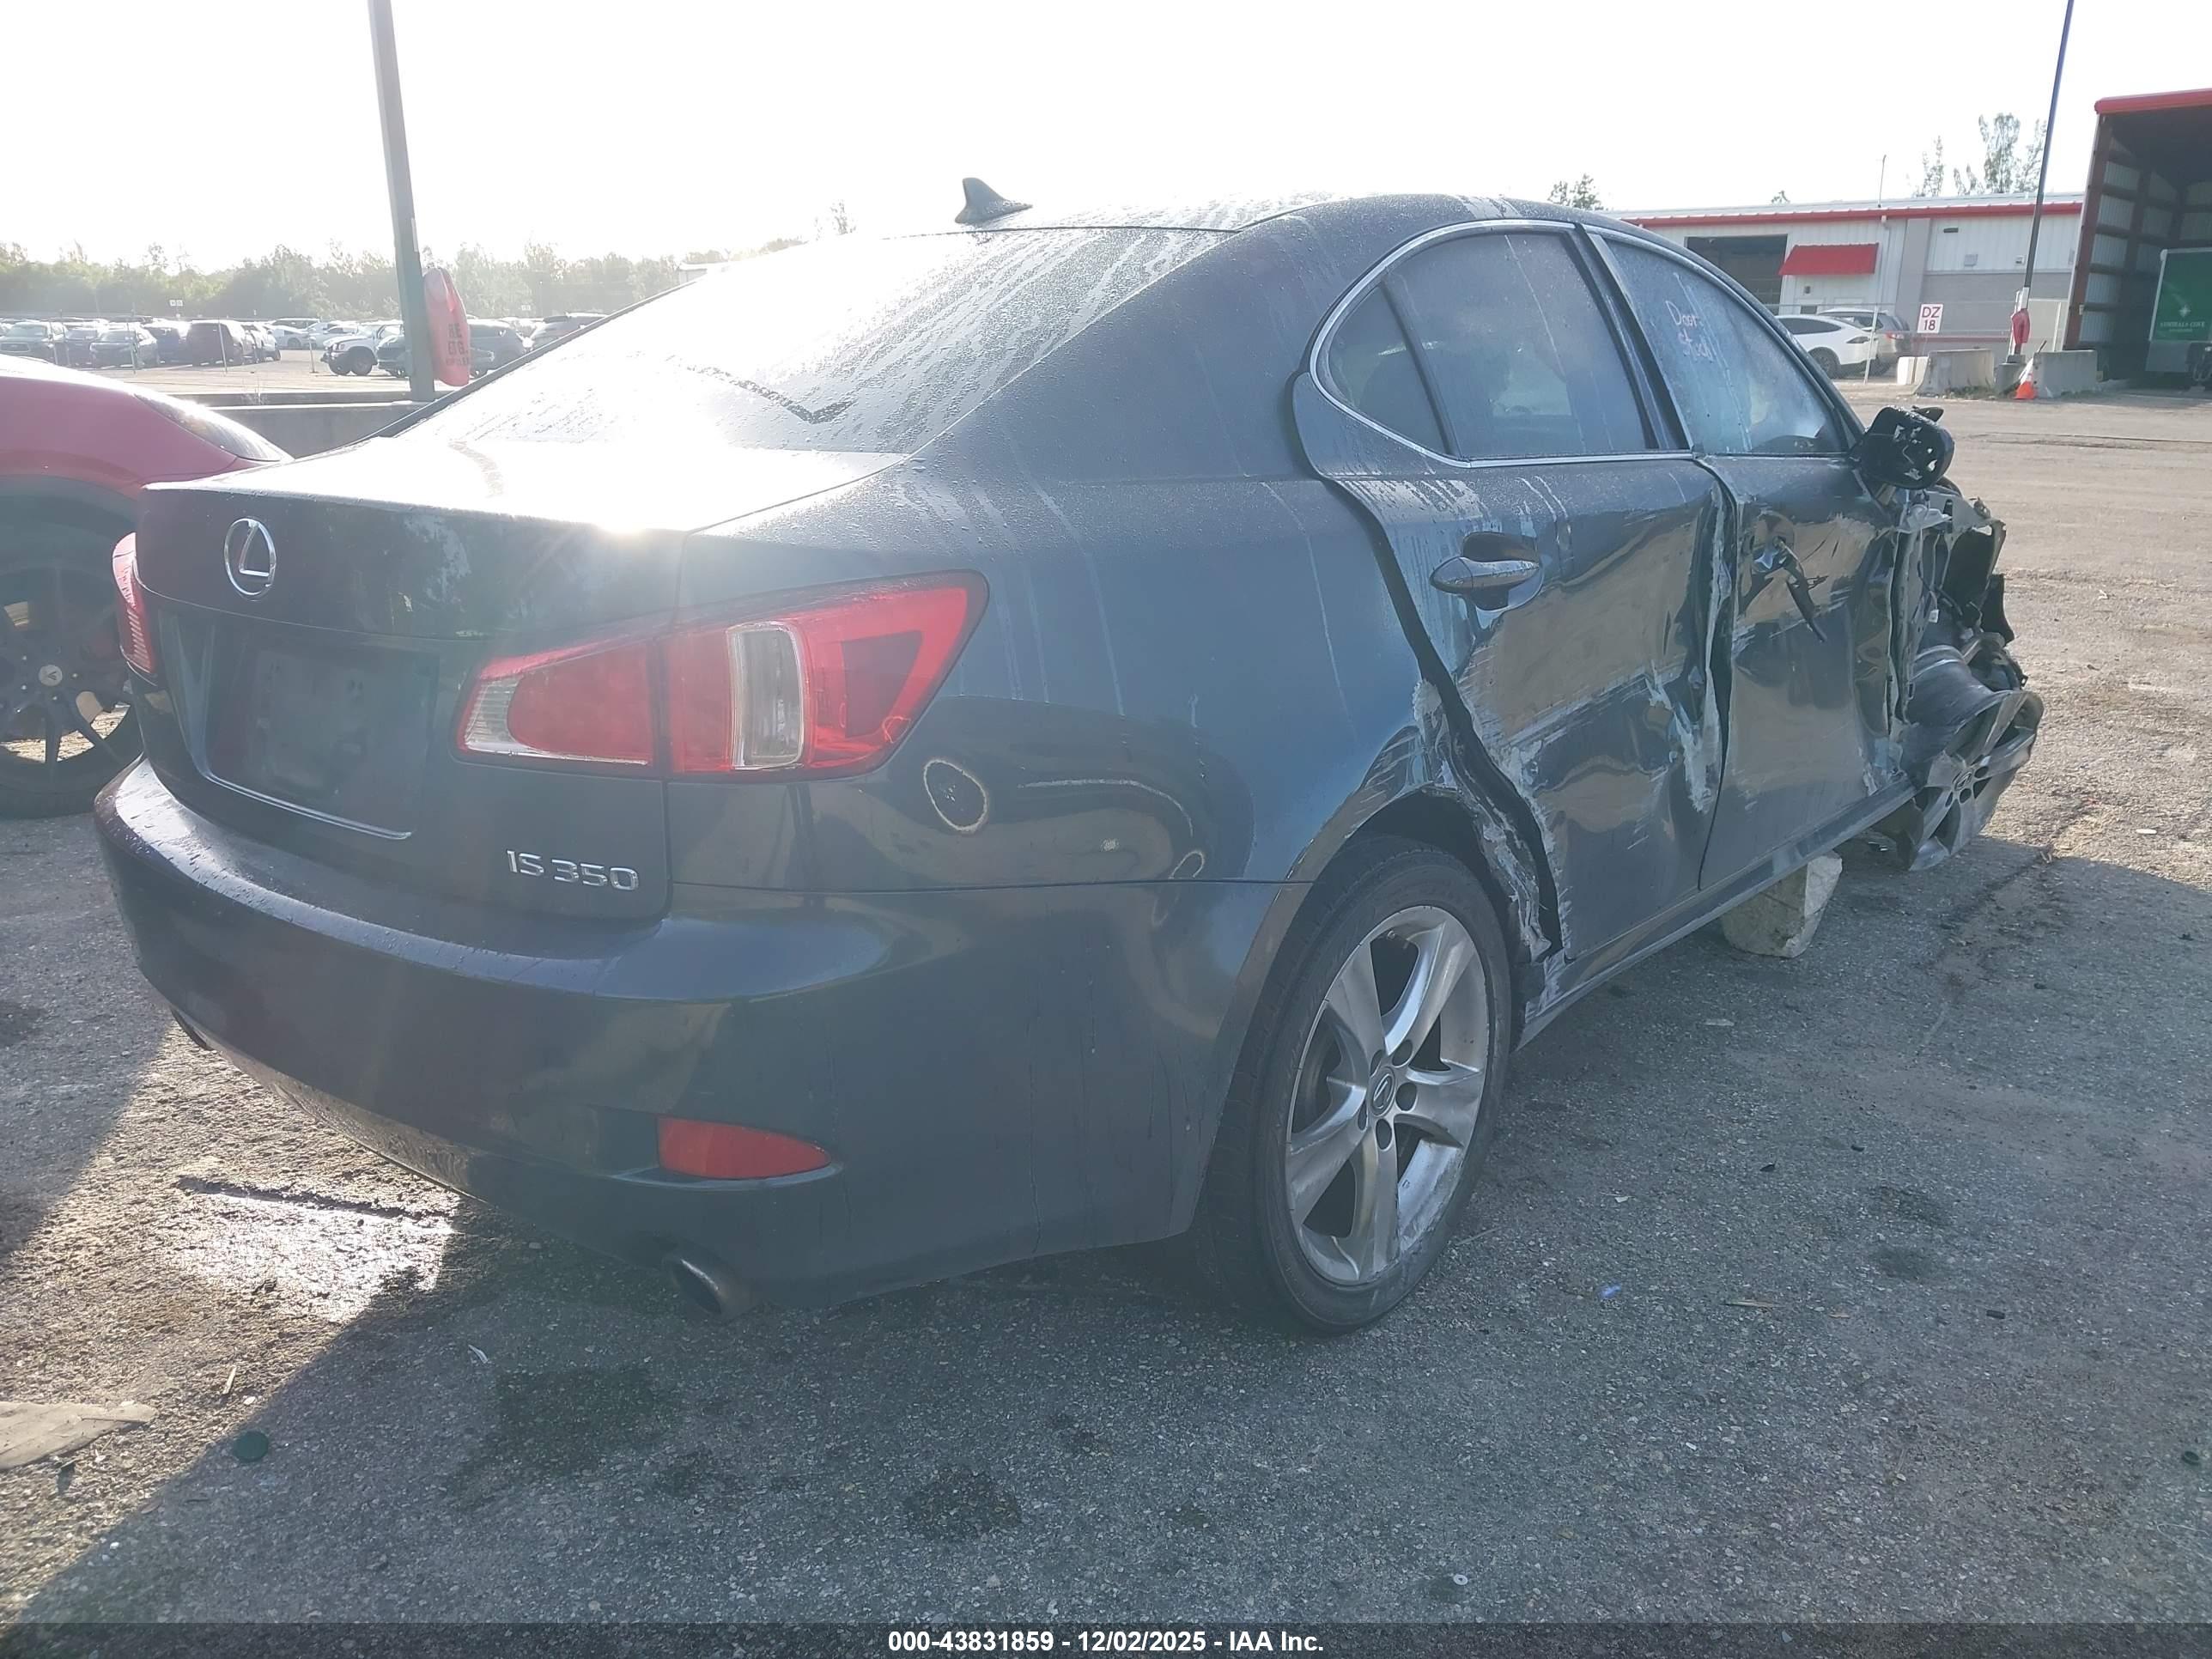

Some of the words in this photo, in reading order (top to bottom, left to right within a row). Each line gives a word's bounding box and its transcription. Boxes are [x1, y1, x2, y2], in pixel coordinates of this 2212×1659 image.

[1922, 307, 1942, 319] DZ
[1923, 319, 1936, 331] 18
[506, 849, 545, 878] IS
[551, 859, 641, 891] 350
